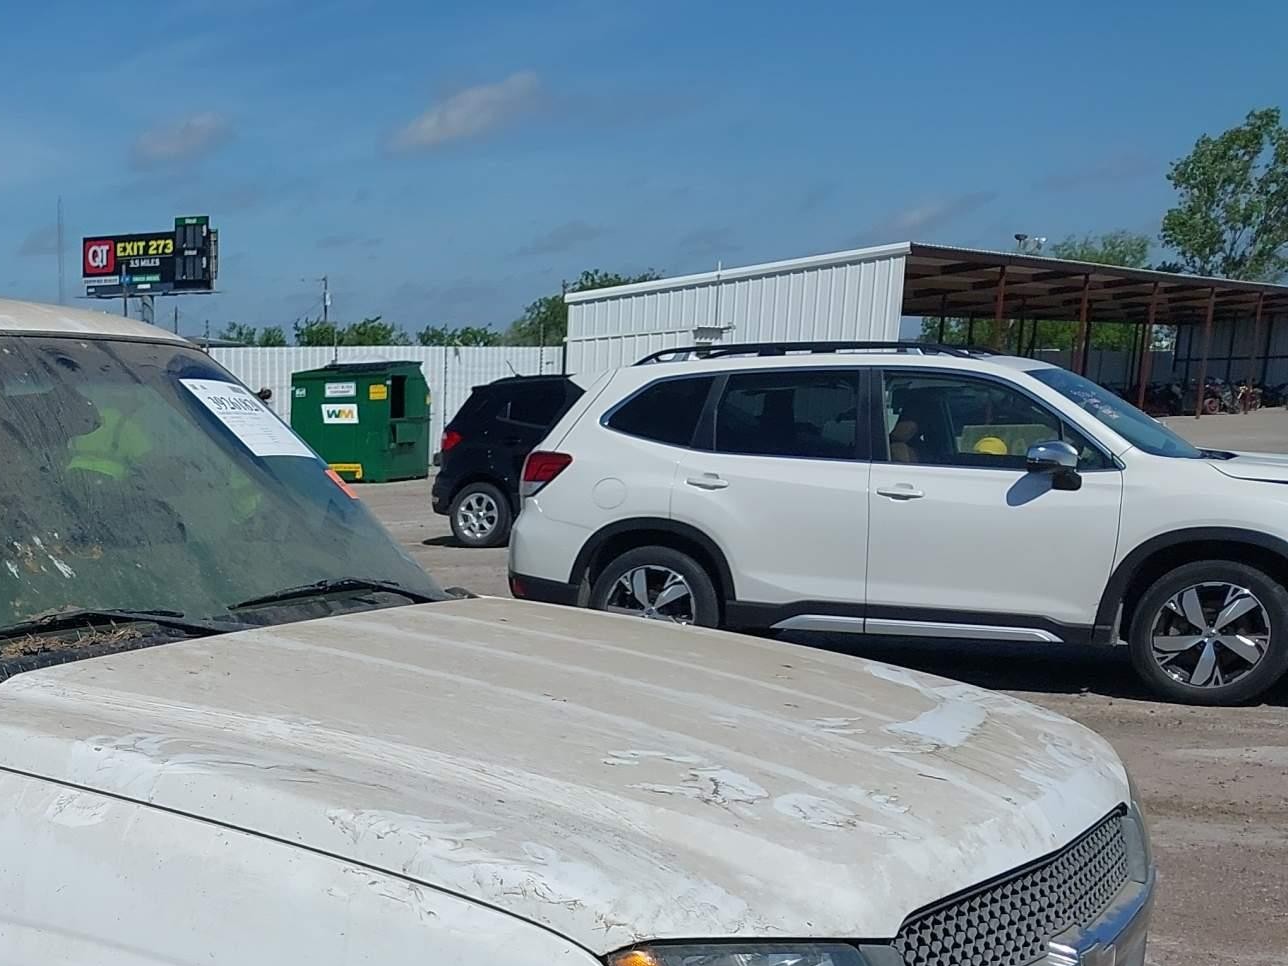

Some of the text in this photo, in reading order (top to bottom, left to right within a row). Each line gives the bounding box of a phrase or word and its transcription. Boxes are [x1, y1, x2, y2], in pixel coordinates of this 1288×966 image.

[88, 245, 110, 268] QT
[116, 239, 174, 257] EXIT 273
[327, 409, 354, 419] WM
